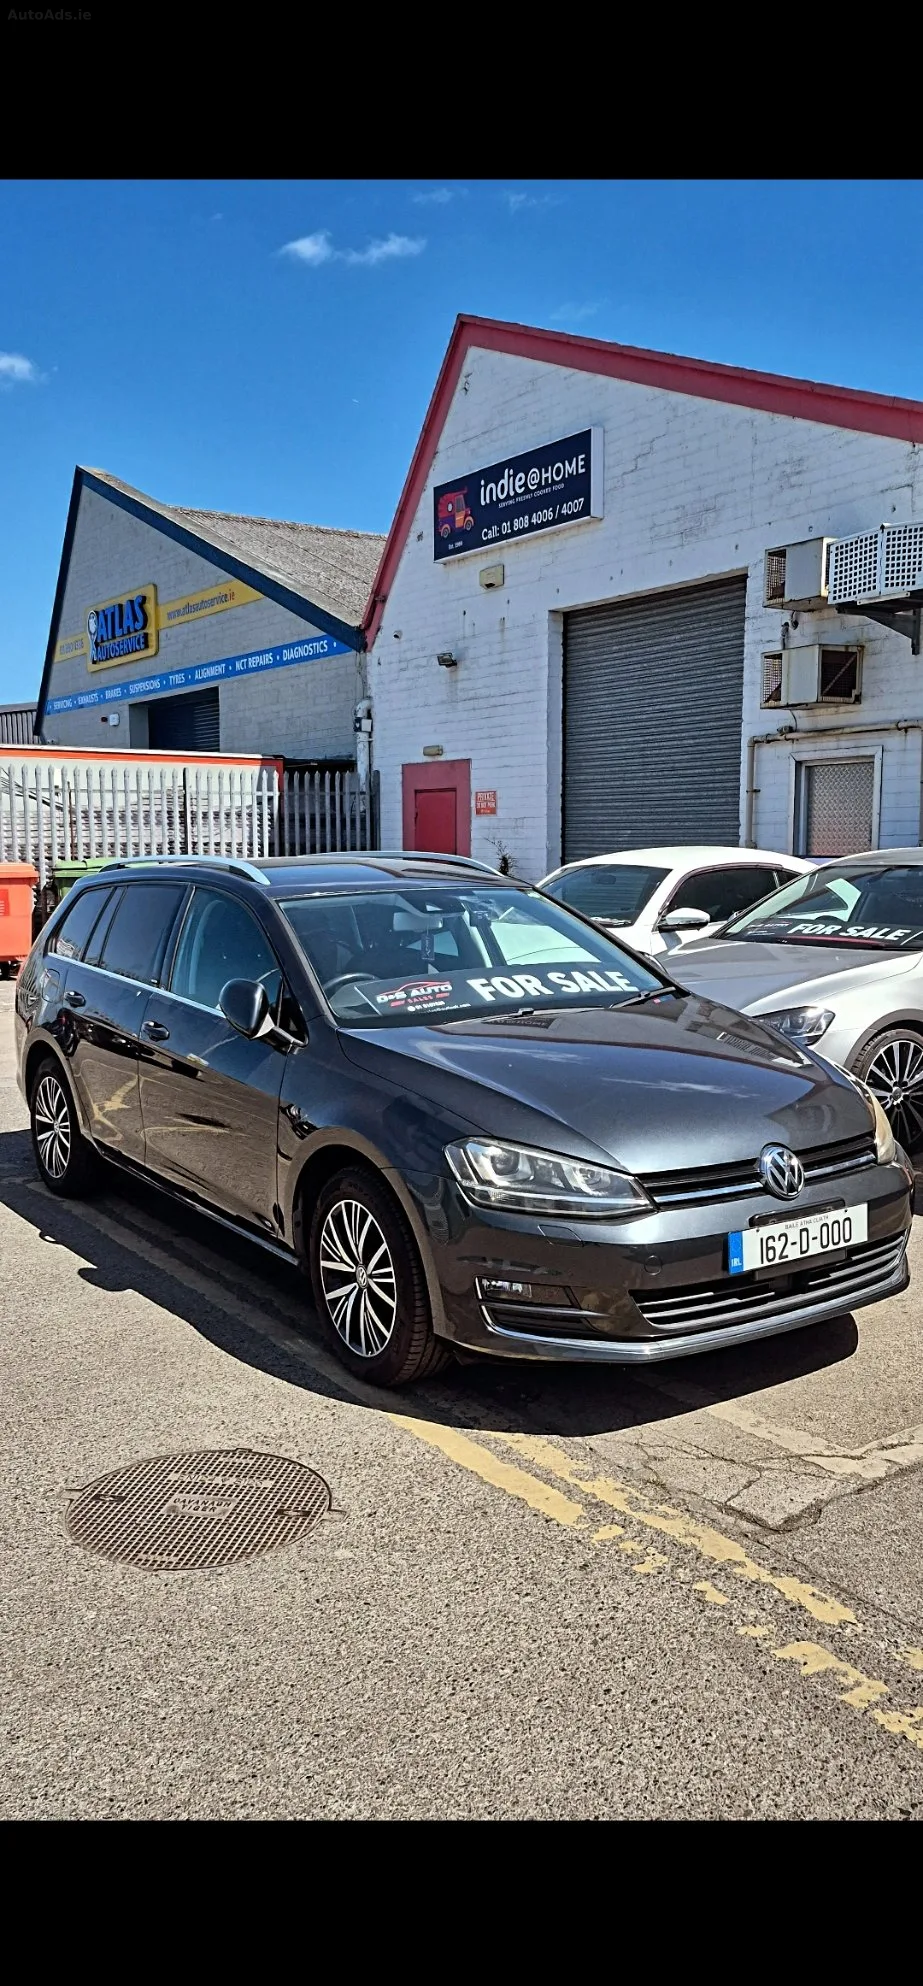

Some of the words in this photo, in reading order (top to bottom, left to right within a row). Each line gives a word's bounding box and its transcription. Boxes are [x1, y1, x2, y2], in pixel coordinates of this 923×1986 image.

[480, 454, 586, 506] indie@HOME
[481, 525, 500, 541] Call:
[501, 521, 511, 535] 01
[513, 515, 529, 531] 808
[531, 507, 554, 526] 4006
[561, 497, 585, 517] 4007
[96, 594, 147, 642] ATLAS
[96, 633, 148, 661] AUTOSERVICE
[129, 679, 161, 695] SUSPENSIONS
[169, 673, 185, 686] TYRES
[194, 663, 226, 681] ALIGNMENT
[235, 659, 247, 671] NCT
[248, 653, 274, 668] REPAIRS
[282, 640, 328, 661] DIAGNOSTICS
[787, 923, 840, 935] FOR
[839, 926, 911, 940] SALE
[410, 984, 453, 997] AUTO
[466, 974, 553, 1001] FOR
[547, 970, 639, 993] SALE
[760, 1216, 853, 1265] 162-D-000
[181, 1505, 217, 1513] TIGER
